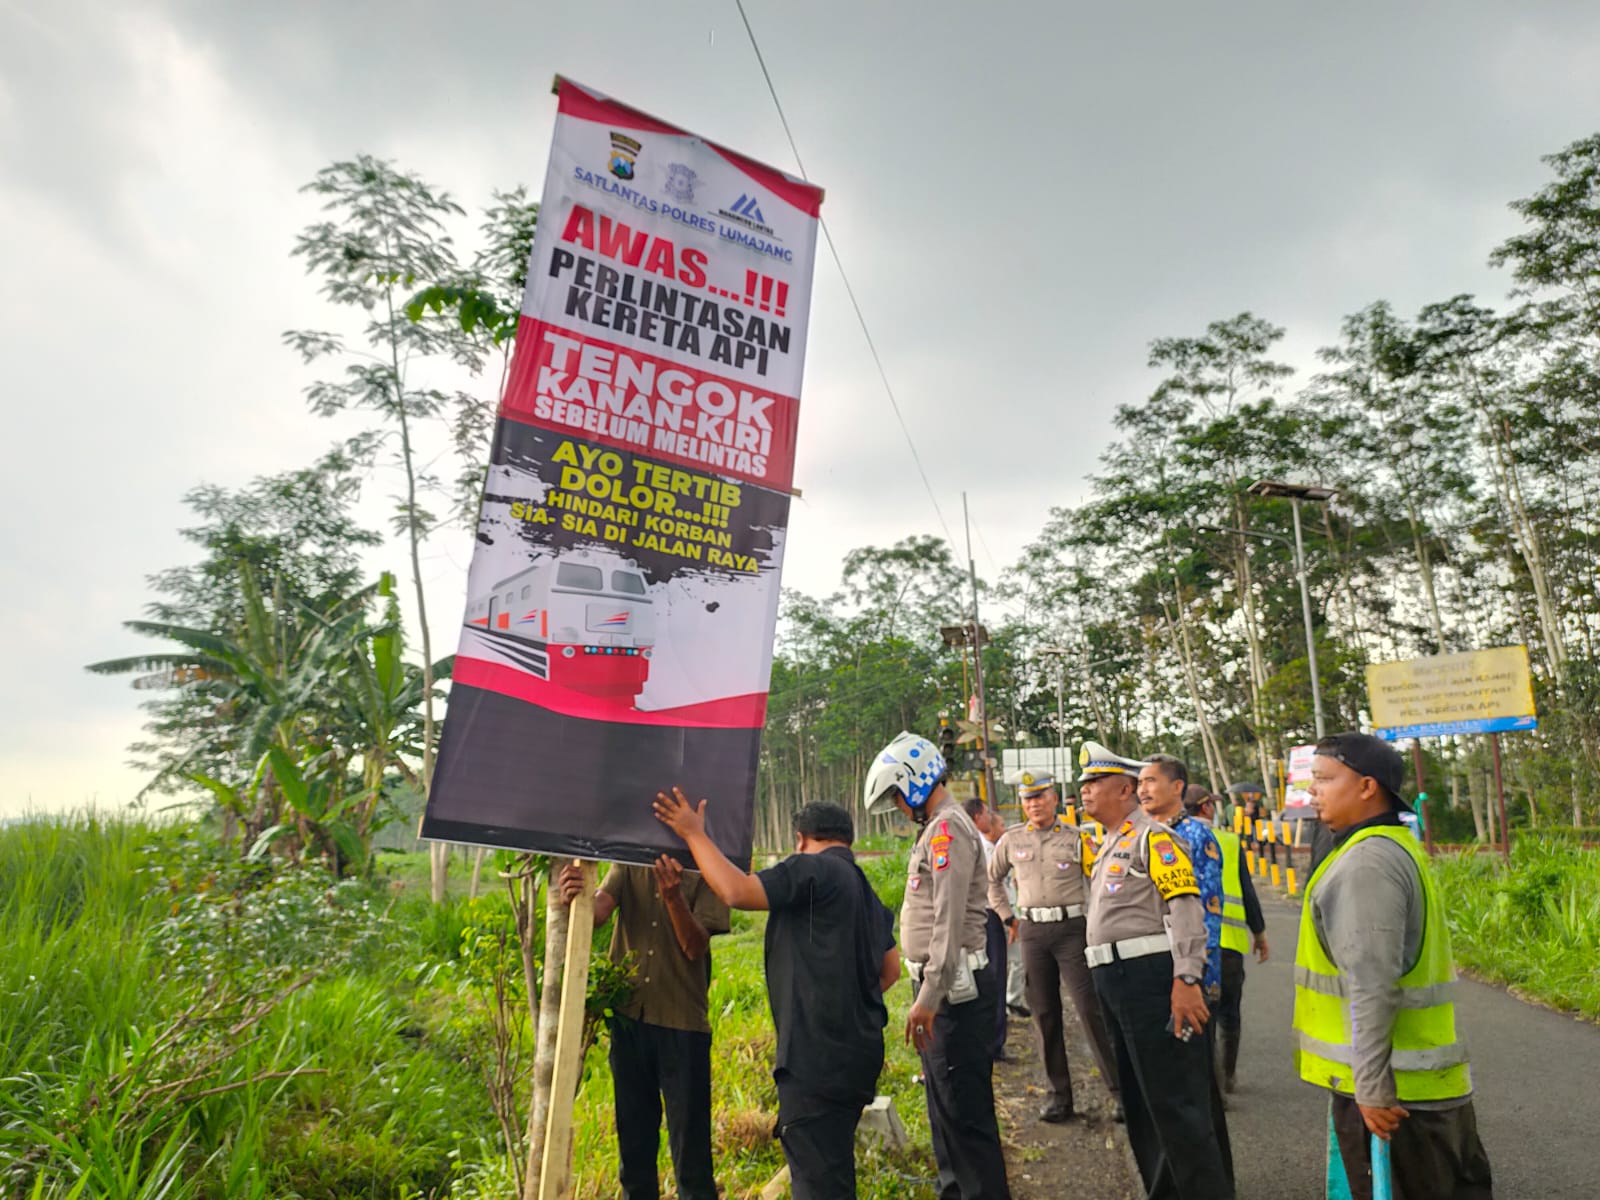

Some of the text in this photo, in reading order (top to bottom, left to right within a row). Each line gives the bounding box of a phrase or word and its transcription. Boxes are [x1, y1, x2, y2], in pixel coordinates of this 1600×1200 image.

[574, 166, 793, 262] SATLANTAS POLRES LUMAJANG
[549, 247, 791, 354] PERLINTASAN
[561, 204, 789, 318] AWAS...!!!
[565, 285, 769, 376] KERETA API
[536, 366, 771, 456] KANAN-KIRI
[543, 331, 775, 431] TENGOK
[535, 395, 768, 478] SEBELUM MELINTAS
[551, 440, 742, 508] AYO TERTIB
[547, 490, 732, 549] HINDARI KORBAN
[561, 513, 598, 538] SIA
[604, 525, 627, 544] DI
[631, 533, 702, 561] JALAN
[707, 547, 760, 574] RAYA
